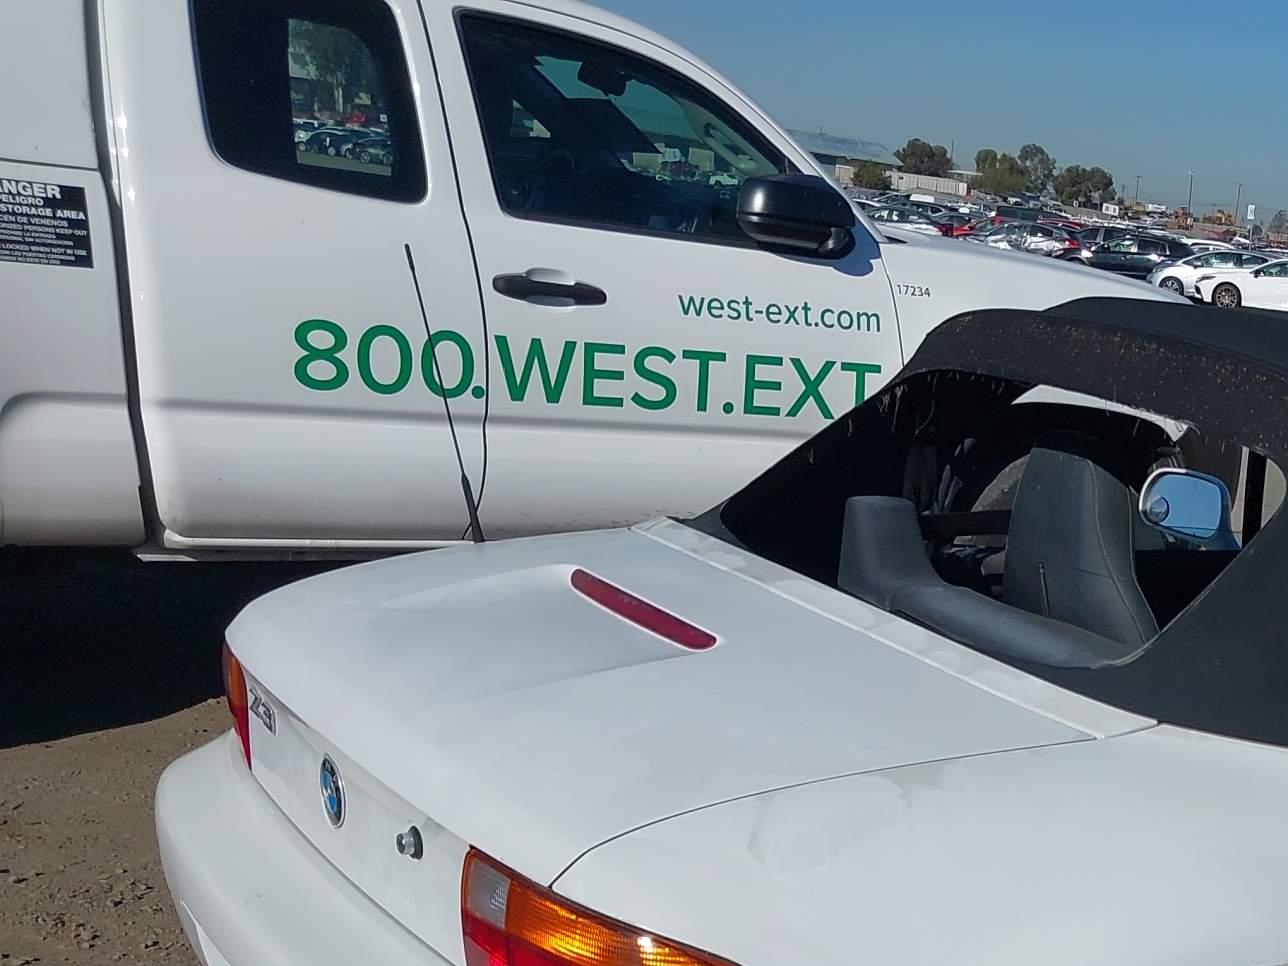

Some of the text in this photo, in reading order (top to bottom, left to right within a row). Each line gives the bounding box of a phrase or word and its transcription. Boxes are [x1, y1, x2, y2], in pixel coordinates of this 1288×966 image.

[0, 180, 61, 199] NGER
[0, 194, 44, 206] ELIGRO
[0, 203, 87, 220] STORAGE AREA
[896, 284, 931, 298] 17234
[678, 293, 882, 333] west-ext.com
